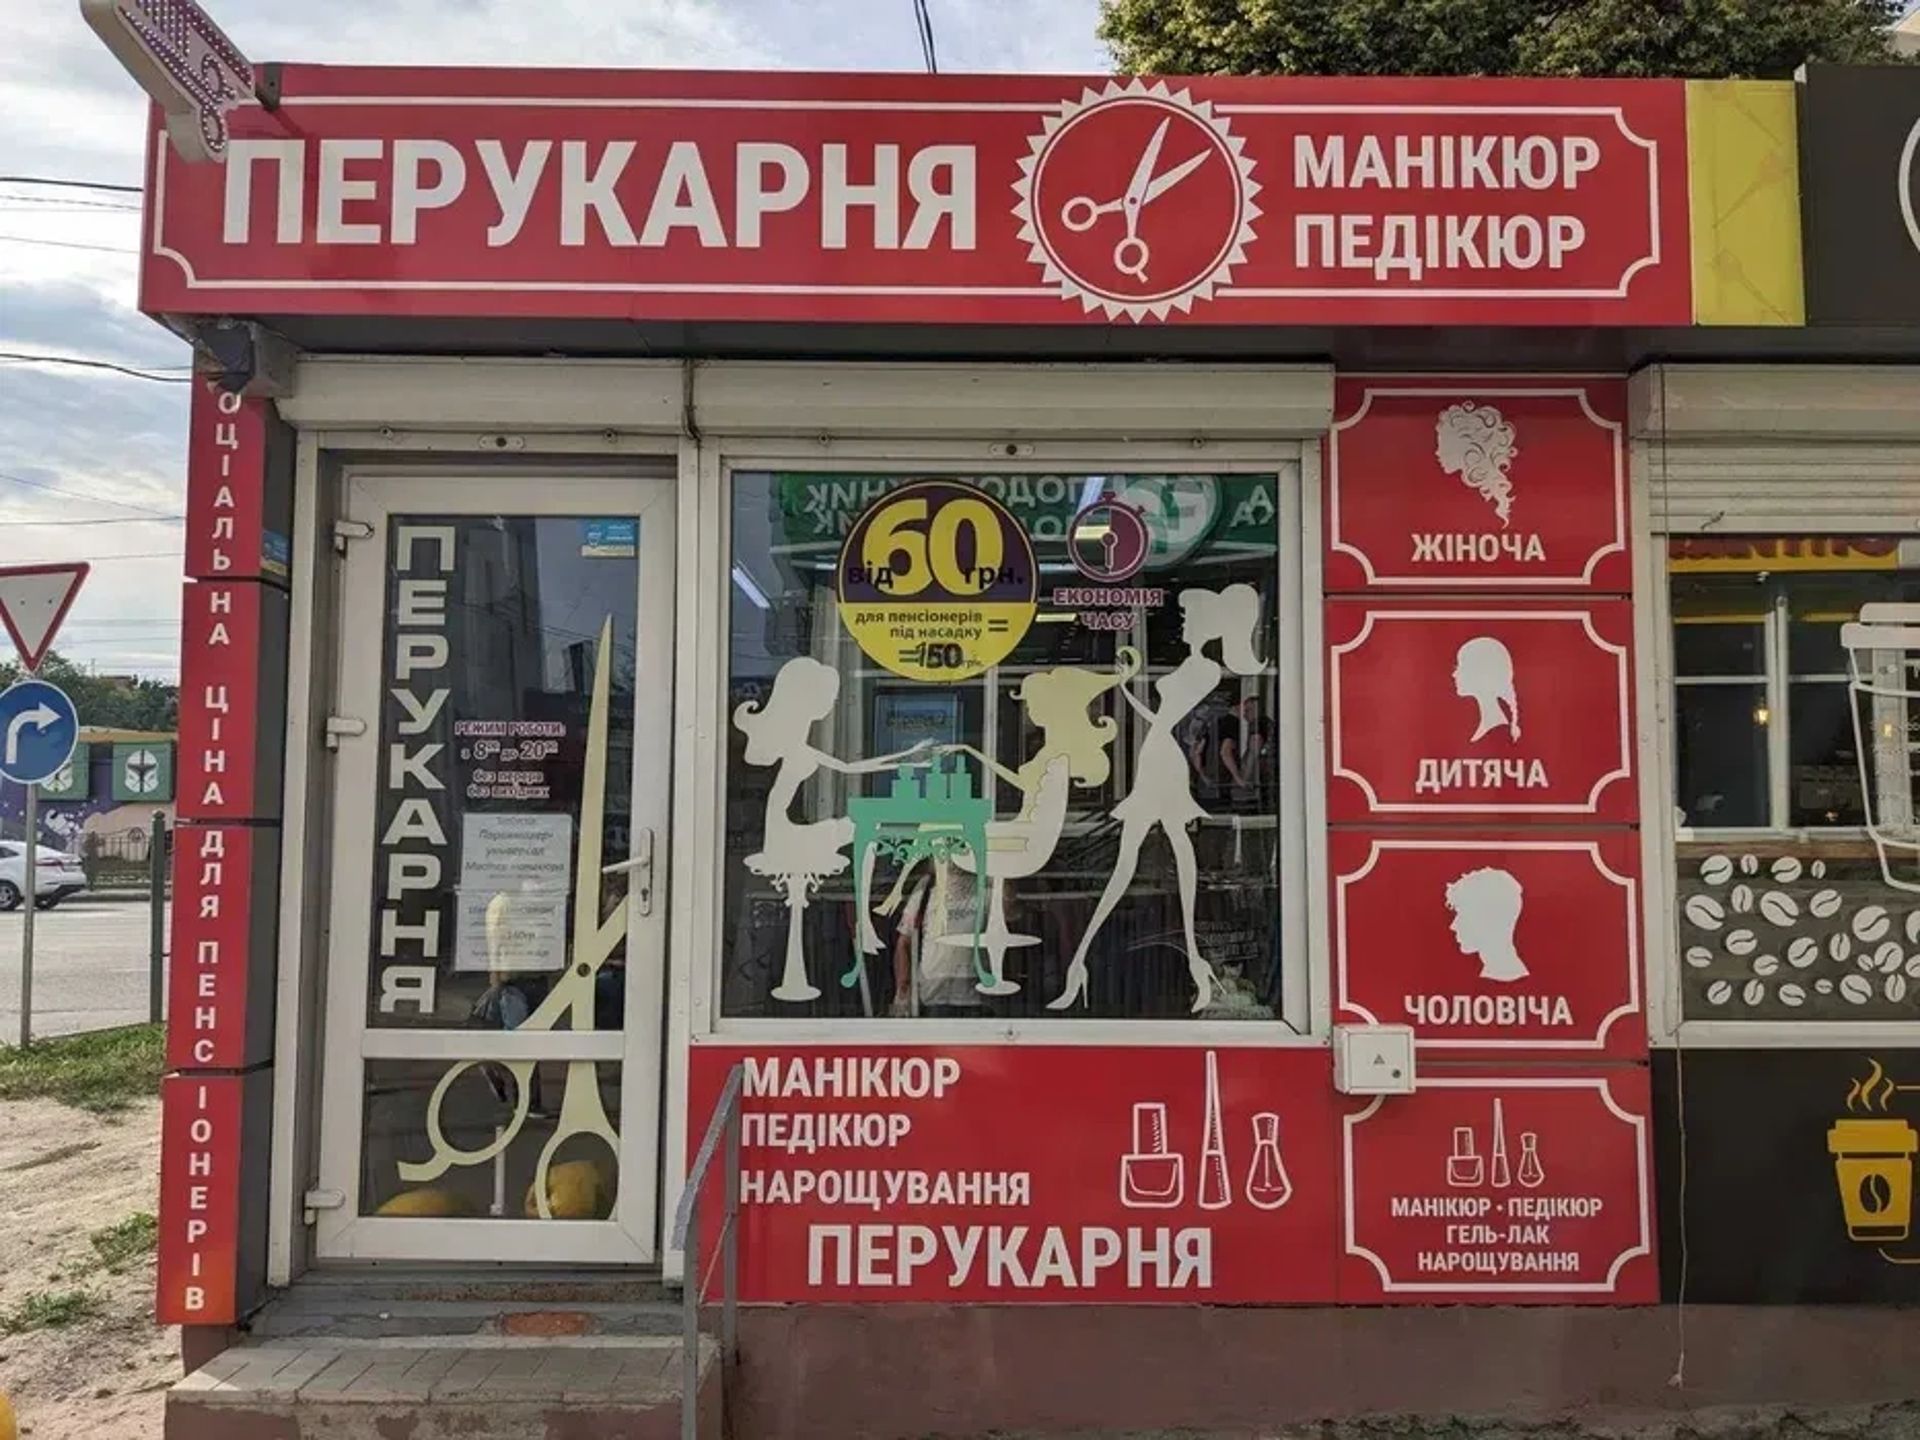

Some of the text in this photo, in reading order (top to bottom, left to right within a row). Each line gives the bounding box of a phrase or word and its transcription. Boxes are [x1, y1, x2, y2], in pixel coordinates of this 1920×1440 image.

[1294, 135, 1600, 189] МАНІКЮР
[223, 139, 977, 250] ПЕРУКАРНЯ
[1295, 215, 1586, 281] ПЕДІКЮР
[862, 498, 1003, 595] 60
[1411, 534, 1547, 562] ЖІНОЧА
[849, 560, 893, 588] від
[964, 565, 1024, 589] грн.
[1053, 588, 1164, 606] ЕКОНОМІЯ
[855, 611, 884, 626] для
[888, 607, 982, 627] пенсіонерів
[890, 623, 982, 641] під насадку
[1081, 612, 1137, 631] ЧАСУ
[454, 721, 507, 736] РЕЖИМ
[380, 526, 456, 1014] ПЕРУКАРНЯ
[500, 748, 519, 762] до
[1415, 758, 1549, 794] ДИТЯЧА
[184, 385, 243, 1311] ОЦІАЛЬНА ЦІНА ДЛЯ ПЕНСІОНЕРІВ
[1404, 994, 1574, 1026] ЧОЛОВІЧА
[742, 1057, 961, 1098] МАНІКЮР
[740, 1113, 911, 1153] ПЕДІКЮР
[740, 1170, 1031, 1211] НАРОЩУВАННЯ
[1391, 1197, 1603, 1221] МАНІКЮР ПЕДІКЮР
[1446, 1225, 1550, 1245] ГЕЛЬ-ЛАК
[808, 1224, 1213, 1289] ПЕРУКАРНЯ
[1418, 1252, 1580, 1275] НАРОЩУВАННЯ
